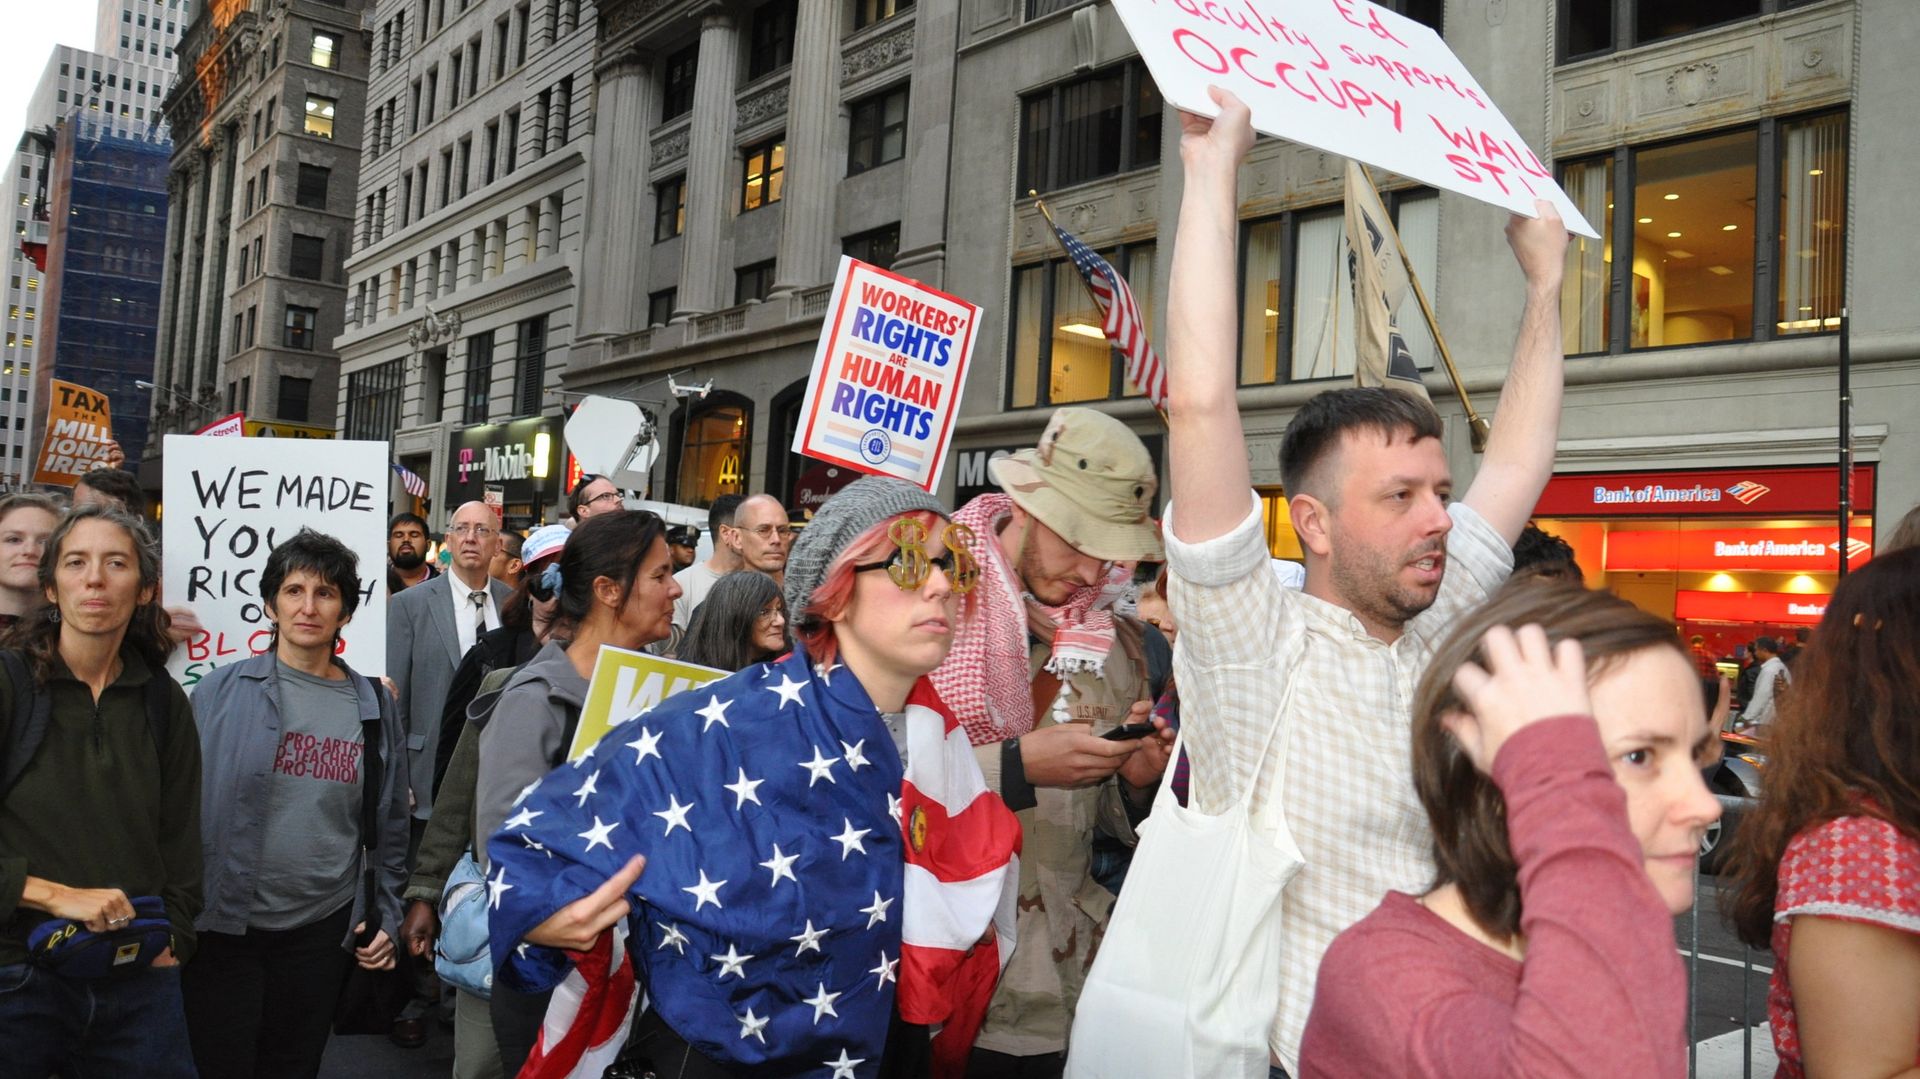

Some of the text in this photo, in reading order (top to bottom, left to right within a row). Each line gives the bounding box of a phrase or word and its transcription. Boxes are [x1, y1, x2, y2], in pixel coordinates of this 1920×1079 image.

[1153, 0, 1487, 109] aculty supports
[1172, 28, 1553, 178] OCCUPY WALL
[861, 281, 966, 336] WORKERS'
[851, 306, 953, 367] RIGHTS
[888, 352, 908, 368] ARE
[839, 351, 943, 410] HUMAN
[58, 387, 106, 416] TAX
[830, 381, 934, 441] RIGHTS
[74, 412, 97, 421] THE
[52, 418, 108, 444] MILL
[48, 437, 110, 461] IONA
[192, 466, 374, 513] WE MADE
[1593, 484, 1721, 503] Bank of America
[1714, 540, 1826, 556] Bank of America
[1788, 603, 1817, 615] Bank
[272, 760, 358, 785] PRO-UNION
